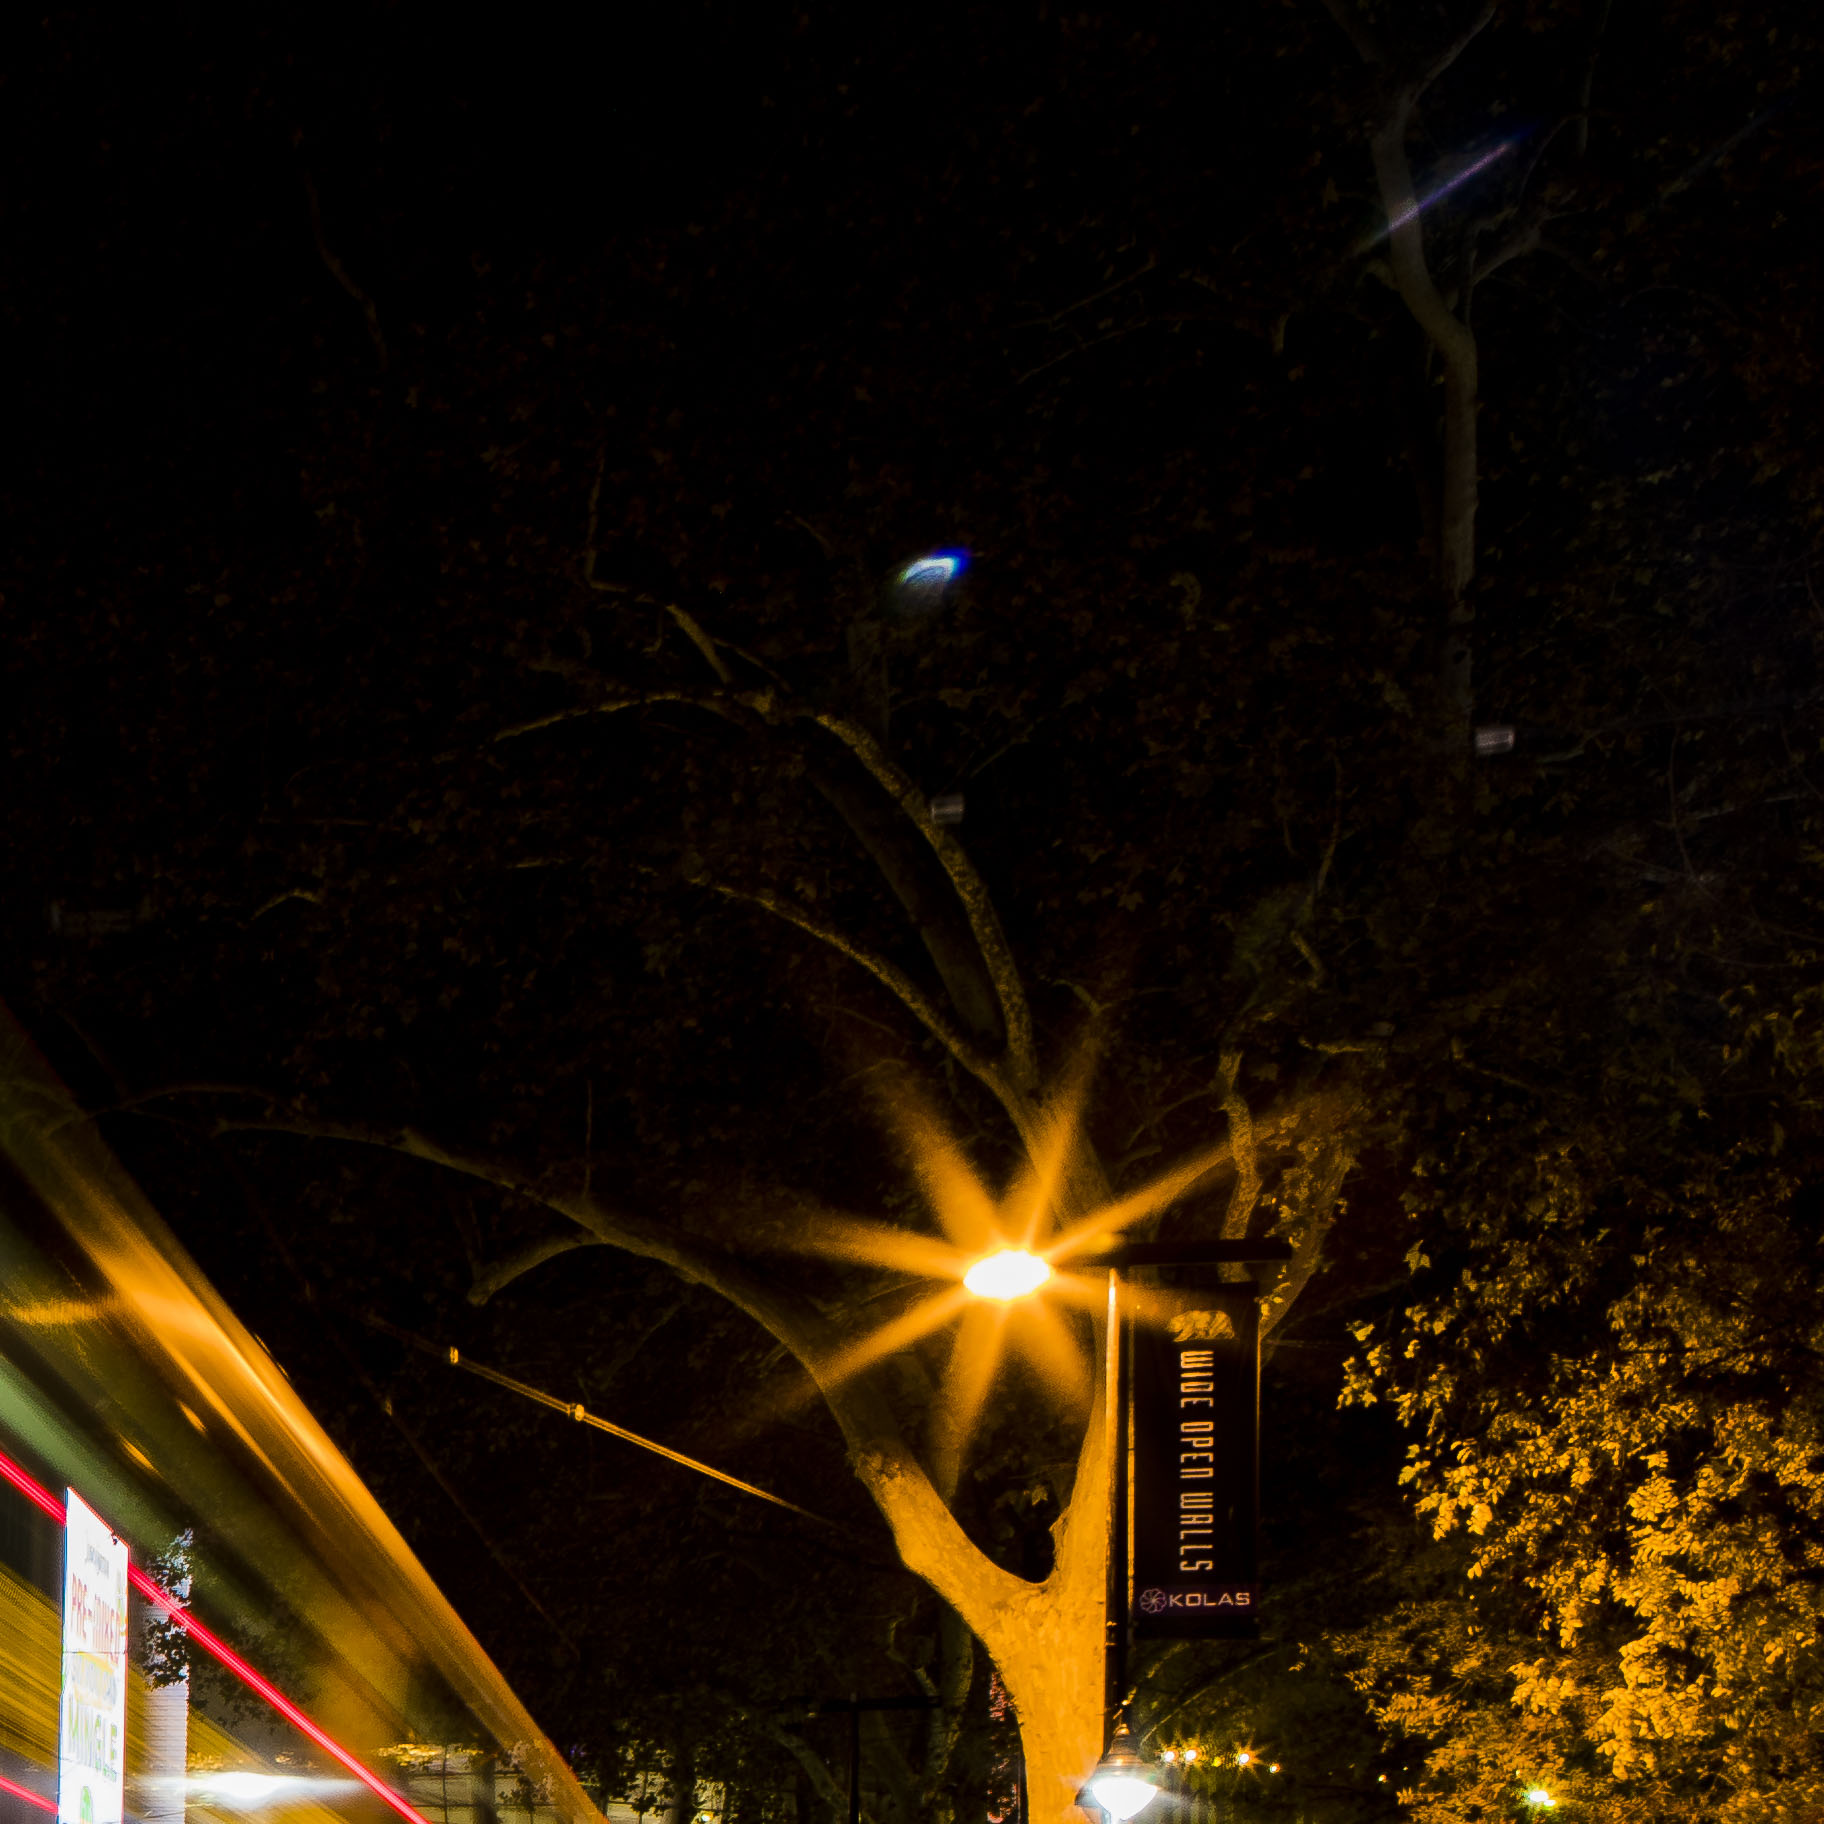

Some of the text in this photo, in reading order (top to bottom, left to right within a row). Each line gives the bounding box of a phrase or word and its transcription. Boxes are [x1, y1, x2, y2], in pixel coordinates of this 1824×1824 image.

[1180, 1350, 1214, 1571] WIDE OPEN WALLS
[1168, 1591, 1251, 1607] KOLAS
